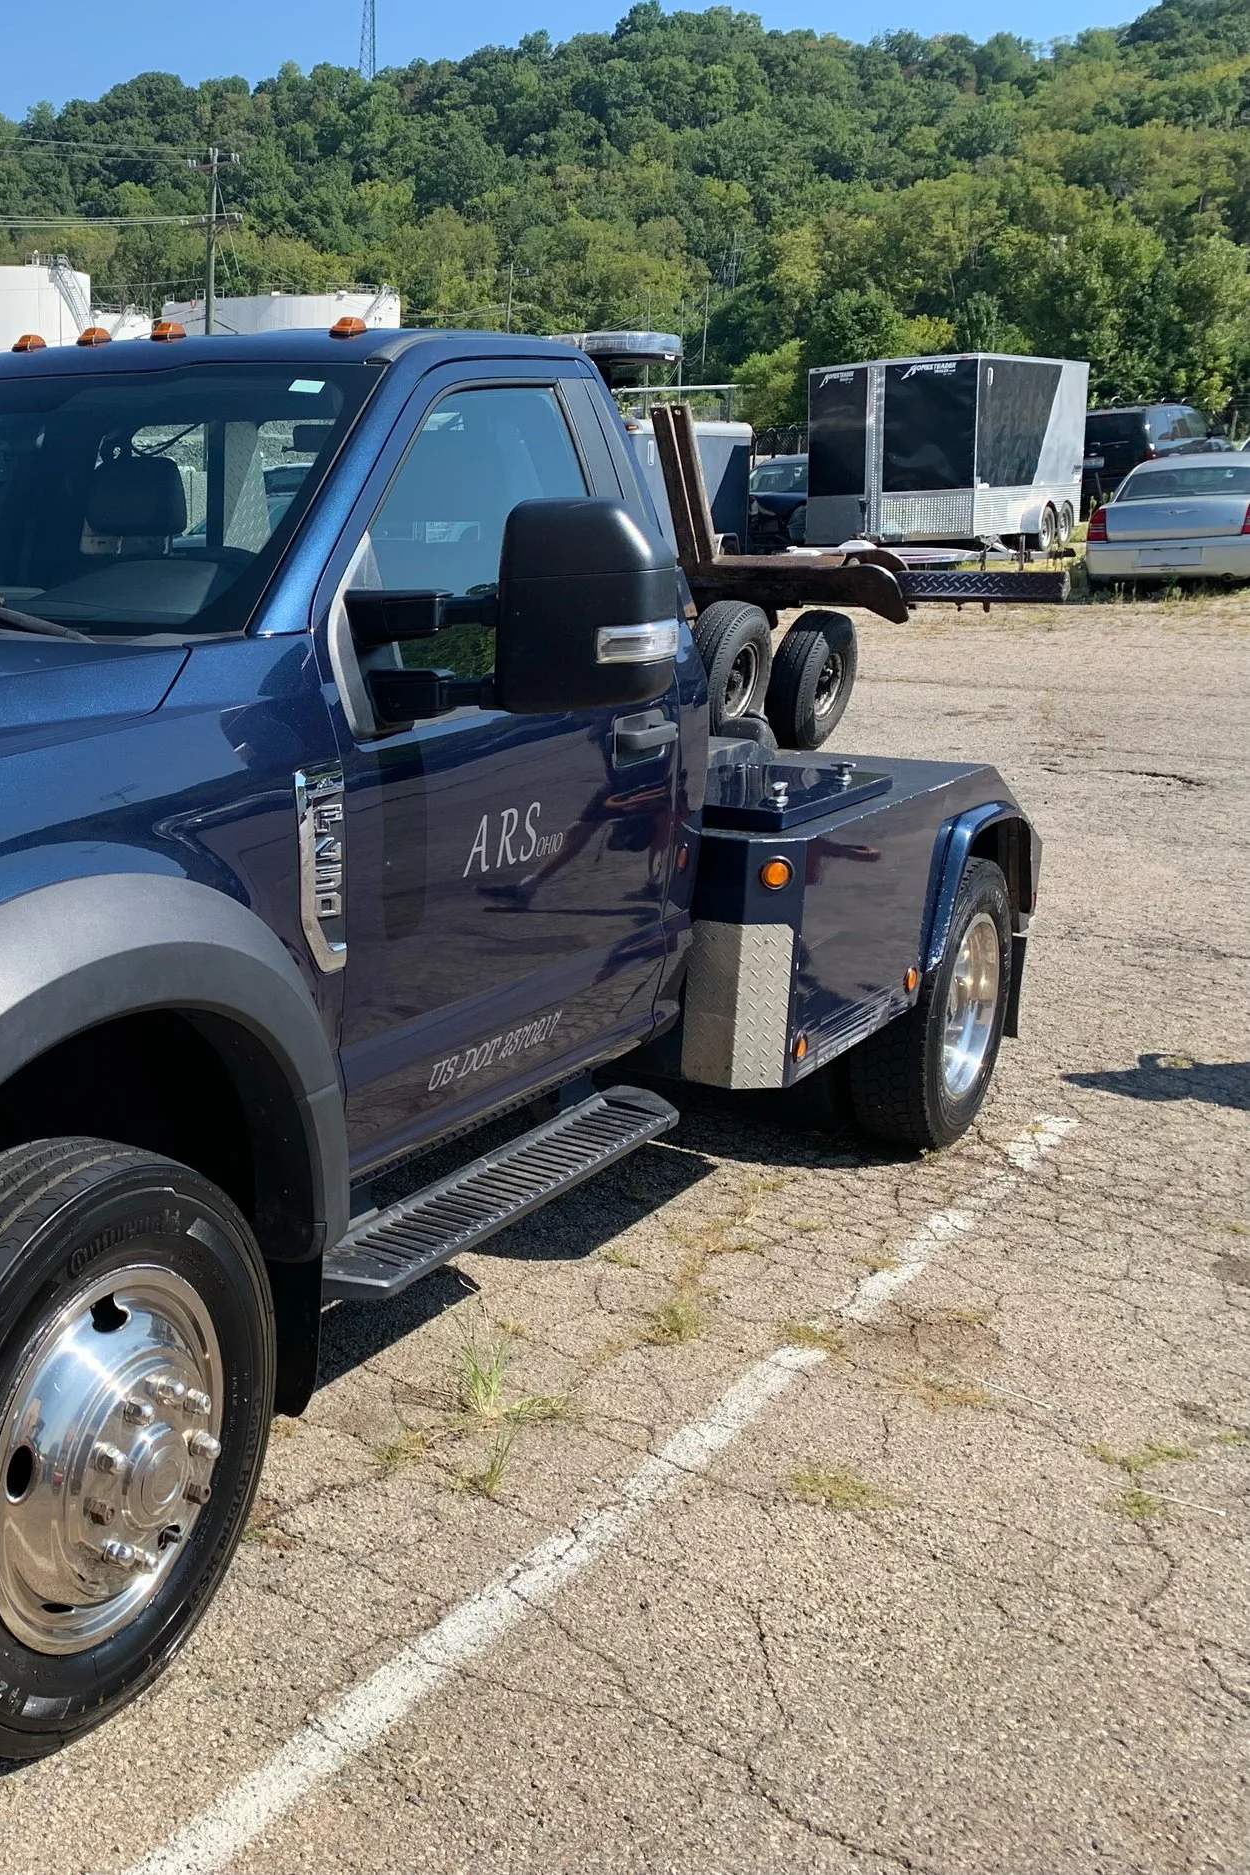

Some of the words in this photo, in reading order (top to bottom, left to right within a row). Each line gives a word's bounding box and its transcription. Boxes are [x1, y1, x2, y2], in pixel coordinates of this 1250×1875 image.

[462, 801, 541, 878] ARS
[428, 1055, 460, 1091] US
[457, 1036, 503, 1079] DOT
